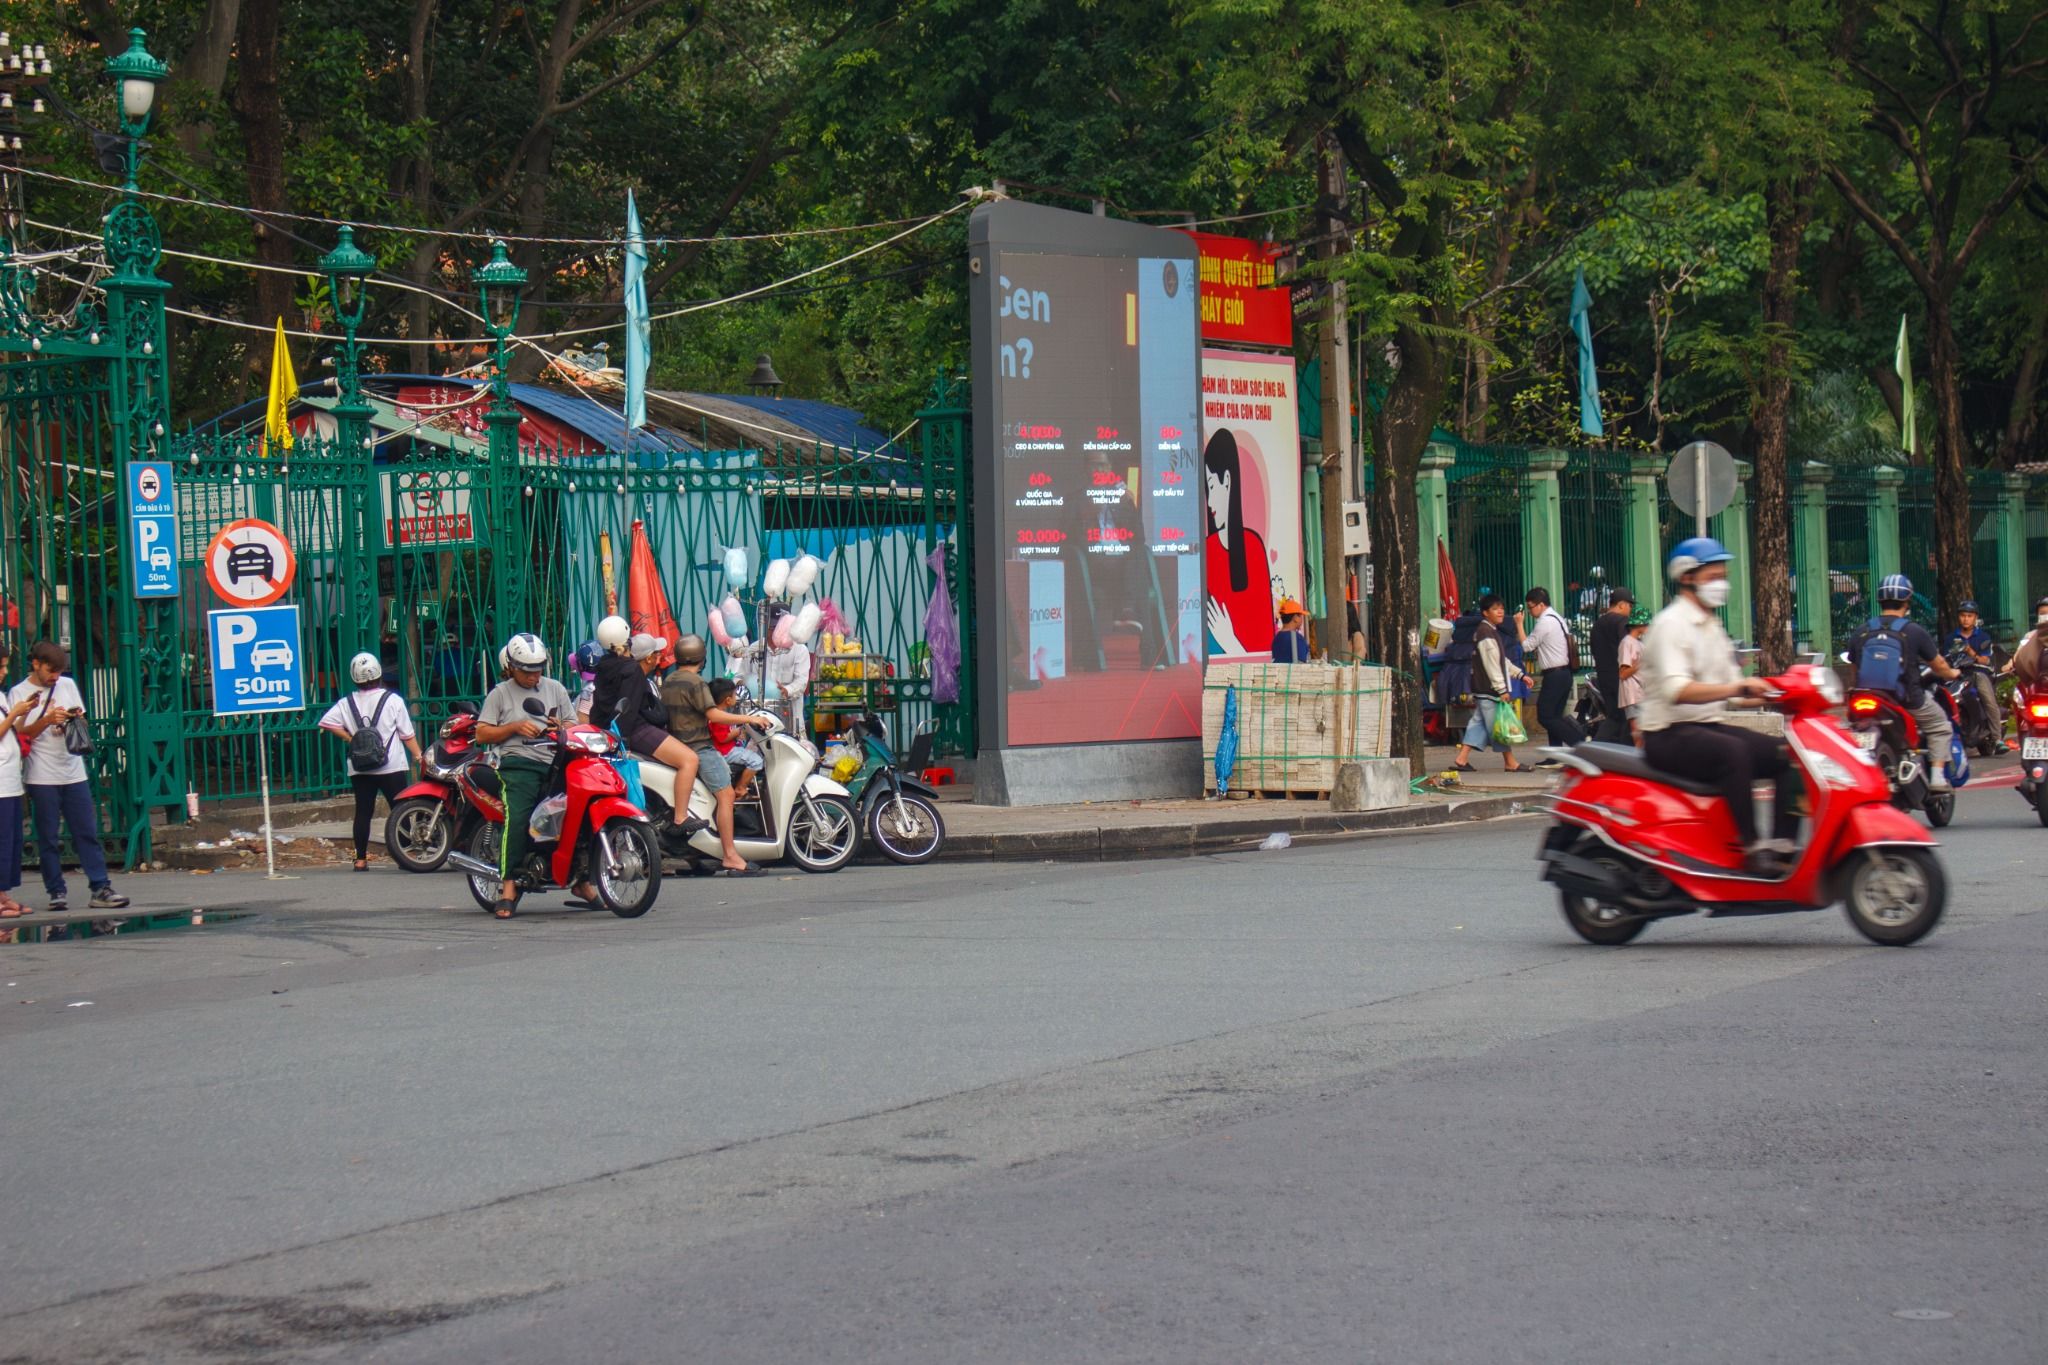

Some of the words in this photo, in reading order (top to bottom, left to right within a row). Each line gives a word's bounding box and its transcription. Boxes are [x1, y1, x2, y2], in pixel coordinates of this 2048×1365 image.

[1223, 252, 1254, 288] QUYẾT
[1224, 290, 1245, 326] GIỎI
[1241, 403, 1254, 420] CON
[138, 520, 159, 561] P
[148, 574, 167, 582] 50m
[216, 614, 258, 670] P
[234, 677, 291, 695] 50m
